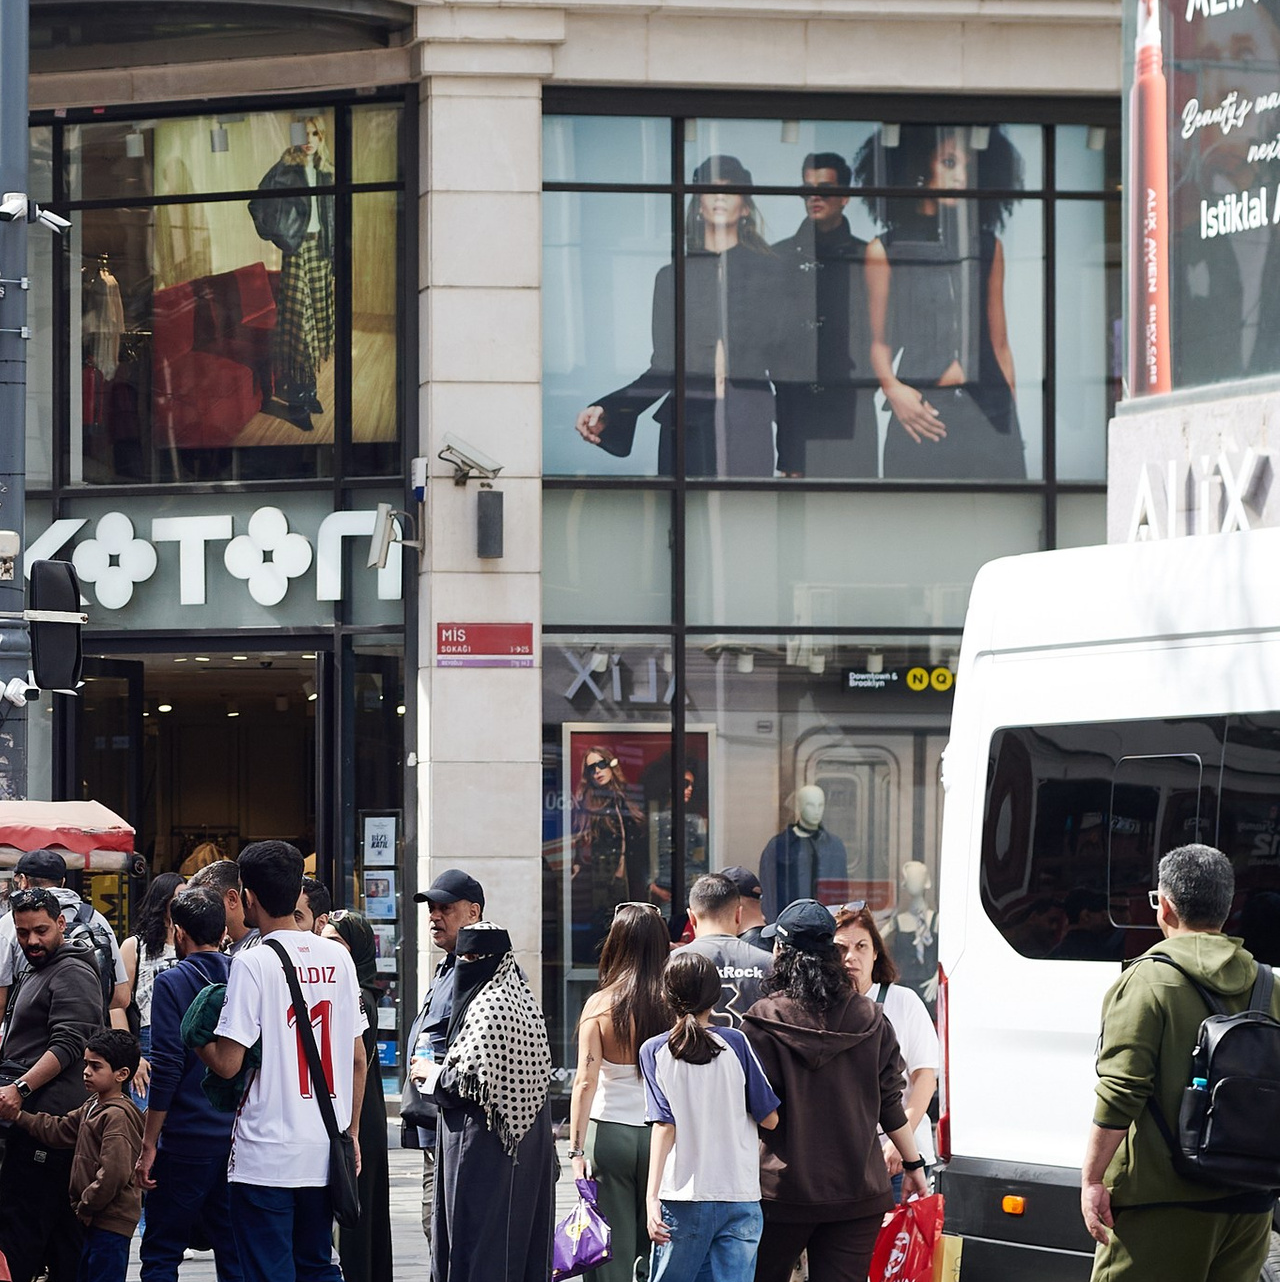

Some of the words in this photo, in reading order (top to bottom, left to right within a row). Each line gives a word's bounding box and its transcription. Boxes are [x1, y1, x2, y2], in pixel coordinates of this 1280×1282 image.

[1147, 237, 1157, 293] AVIEN
[441, 627, 466, 642] MİS
[441, 645, 471, 653] SOKAĞI
[849, 672, 890, 680] Downtown
[849, 680, 885, 688] Brooklyn
[287, 1000, 336, 1099] 11
